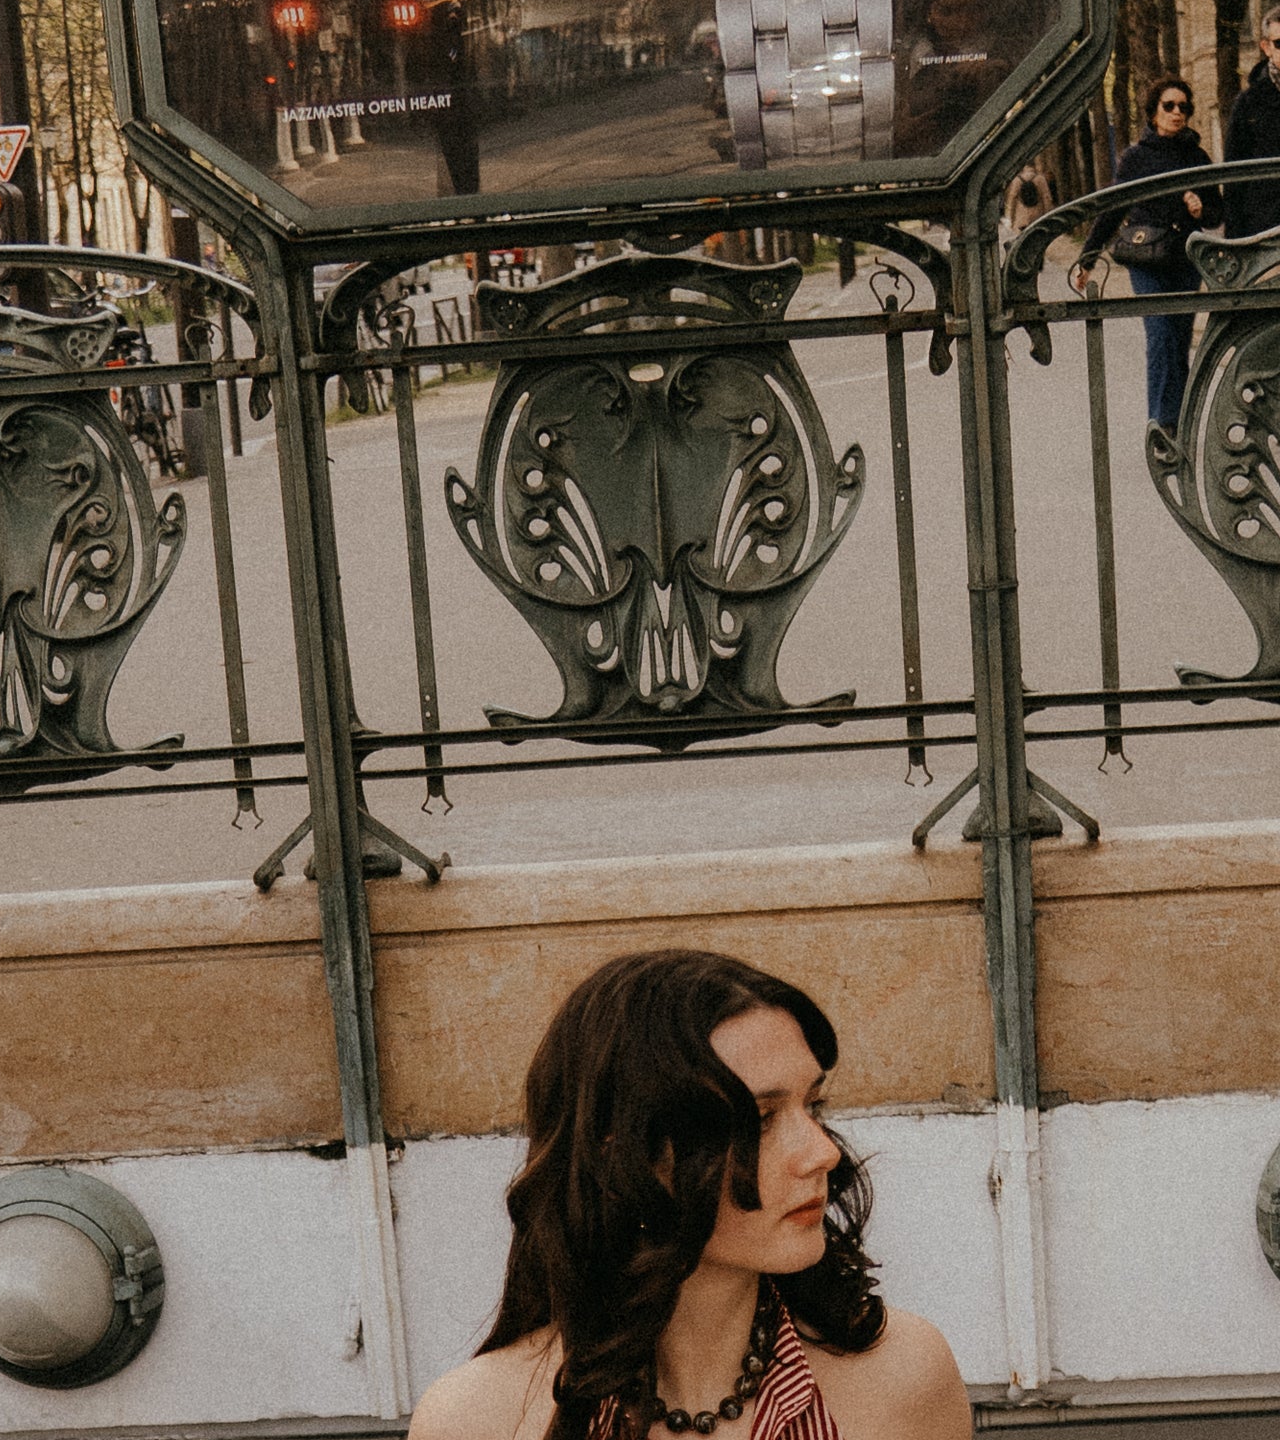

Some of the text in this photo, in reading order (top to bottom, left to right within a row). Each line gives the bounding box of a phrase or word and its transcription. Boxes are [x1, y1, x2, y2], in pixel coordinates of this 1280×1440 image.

[282, 94, 452, 123] JAZZMASTER OPEN HEART
